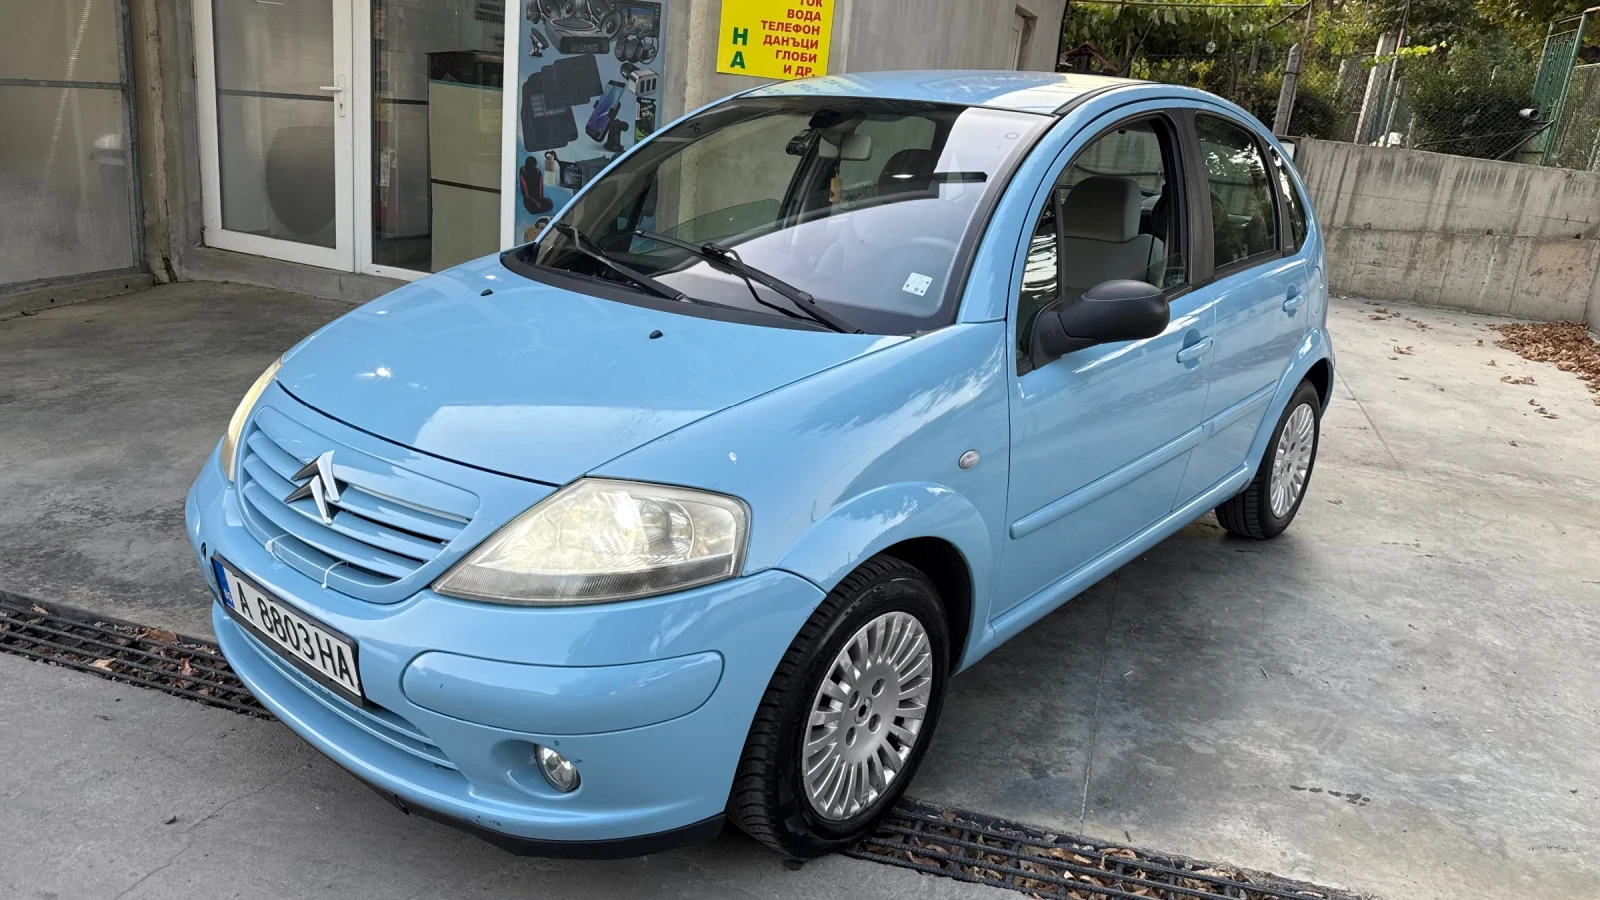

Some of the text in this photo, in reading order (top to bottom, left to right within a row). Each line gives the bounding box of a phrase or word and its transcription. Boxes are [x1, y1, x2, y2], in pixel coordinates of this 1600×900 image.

[787, 9, 821, 22] ВОДА
[761, 20, 820, 35] ТЕЛЕФОН
[763, 35, 819, 50] ДАНЪЦИ
[775, 50, 817, 63] ГЛОБИ
[783, 65, 816, 77] И ДР.
